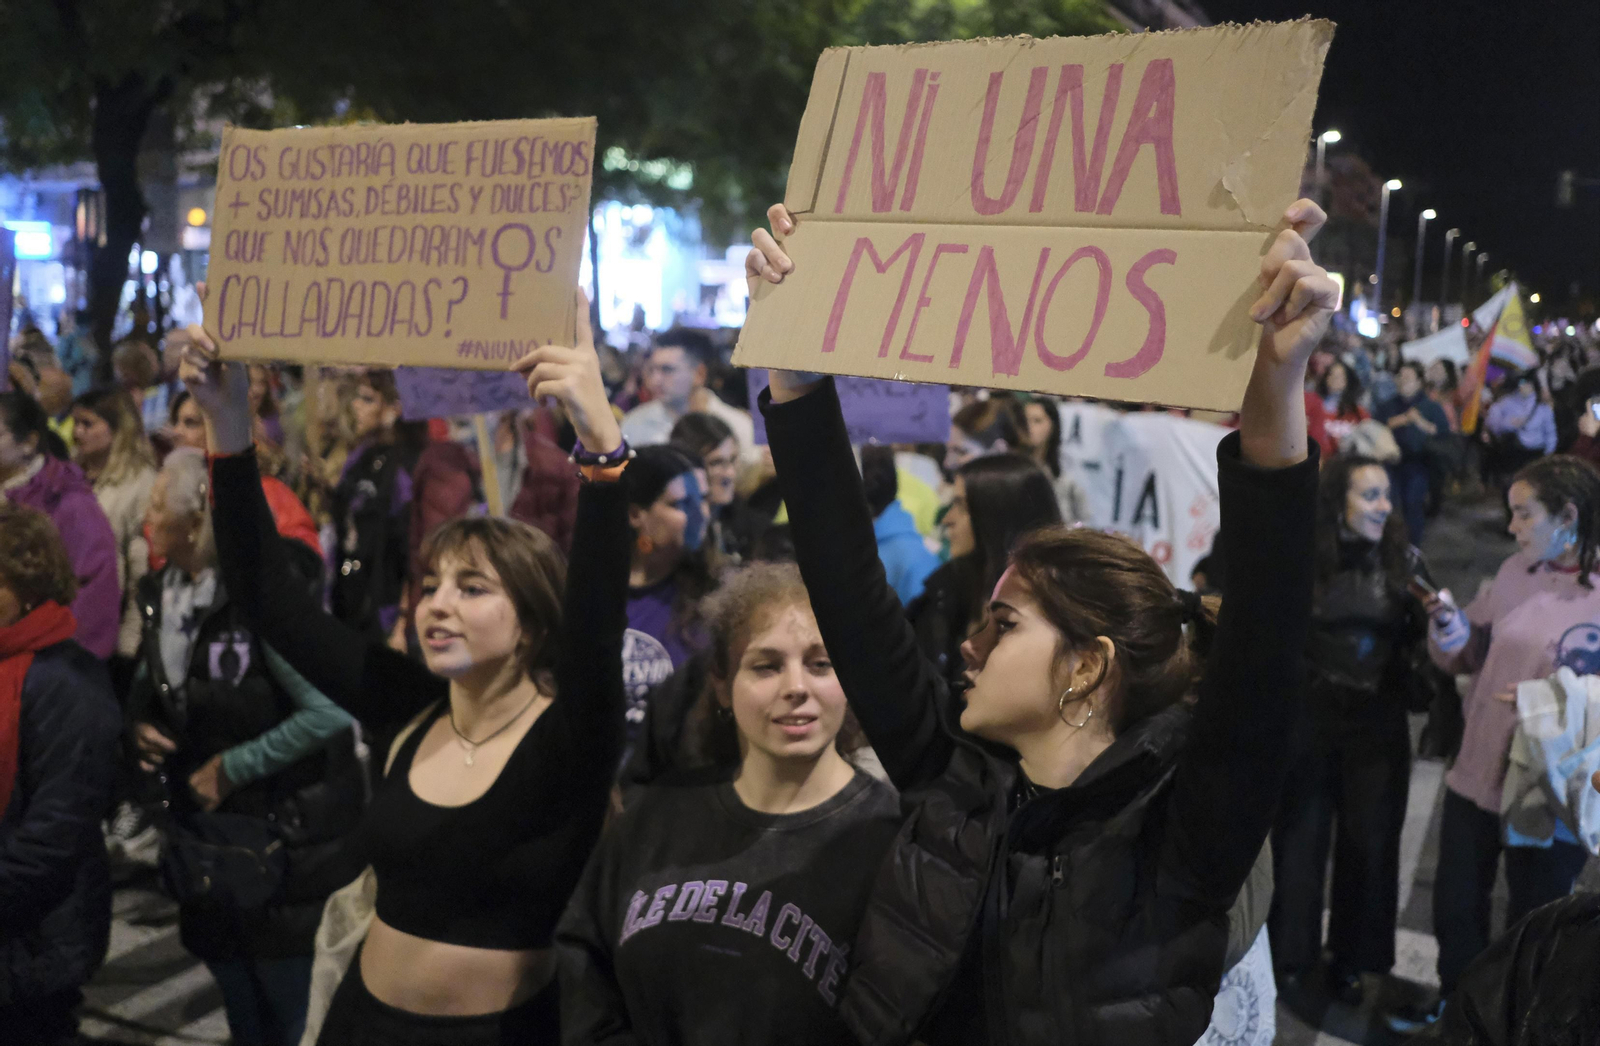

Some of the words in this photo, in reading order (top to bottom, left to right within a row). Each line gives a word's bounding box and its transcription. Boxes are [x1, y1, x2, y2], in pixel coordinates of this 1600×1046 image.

[229, 143, 267, 182] OS
[278, 136, 397, 181] GUSTARÍA
[406, 141, 459, 175] QUE
[465, 135, 590, 181] FUESEMOS
[969, 57, 1182, 217] UNA
[364, 178, 463, 216] DÉBILES
[468, 185, 485, 215] Y
[224, 228, 274, 264] QUE
[282, 226, 333, 267] NOS
[217, 274, 469, 342] CALLADADAS?
[820, 231, 1178, 379] MENOS
[667, 879, 729, 923] DE
[721, 881, 773, 937] LA
